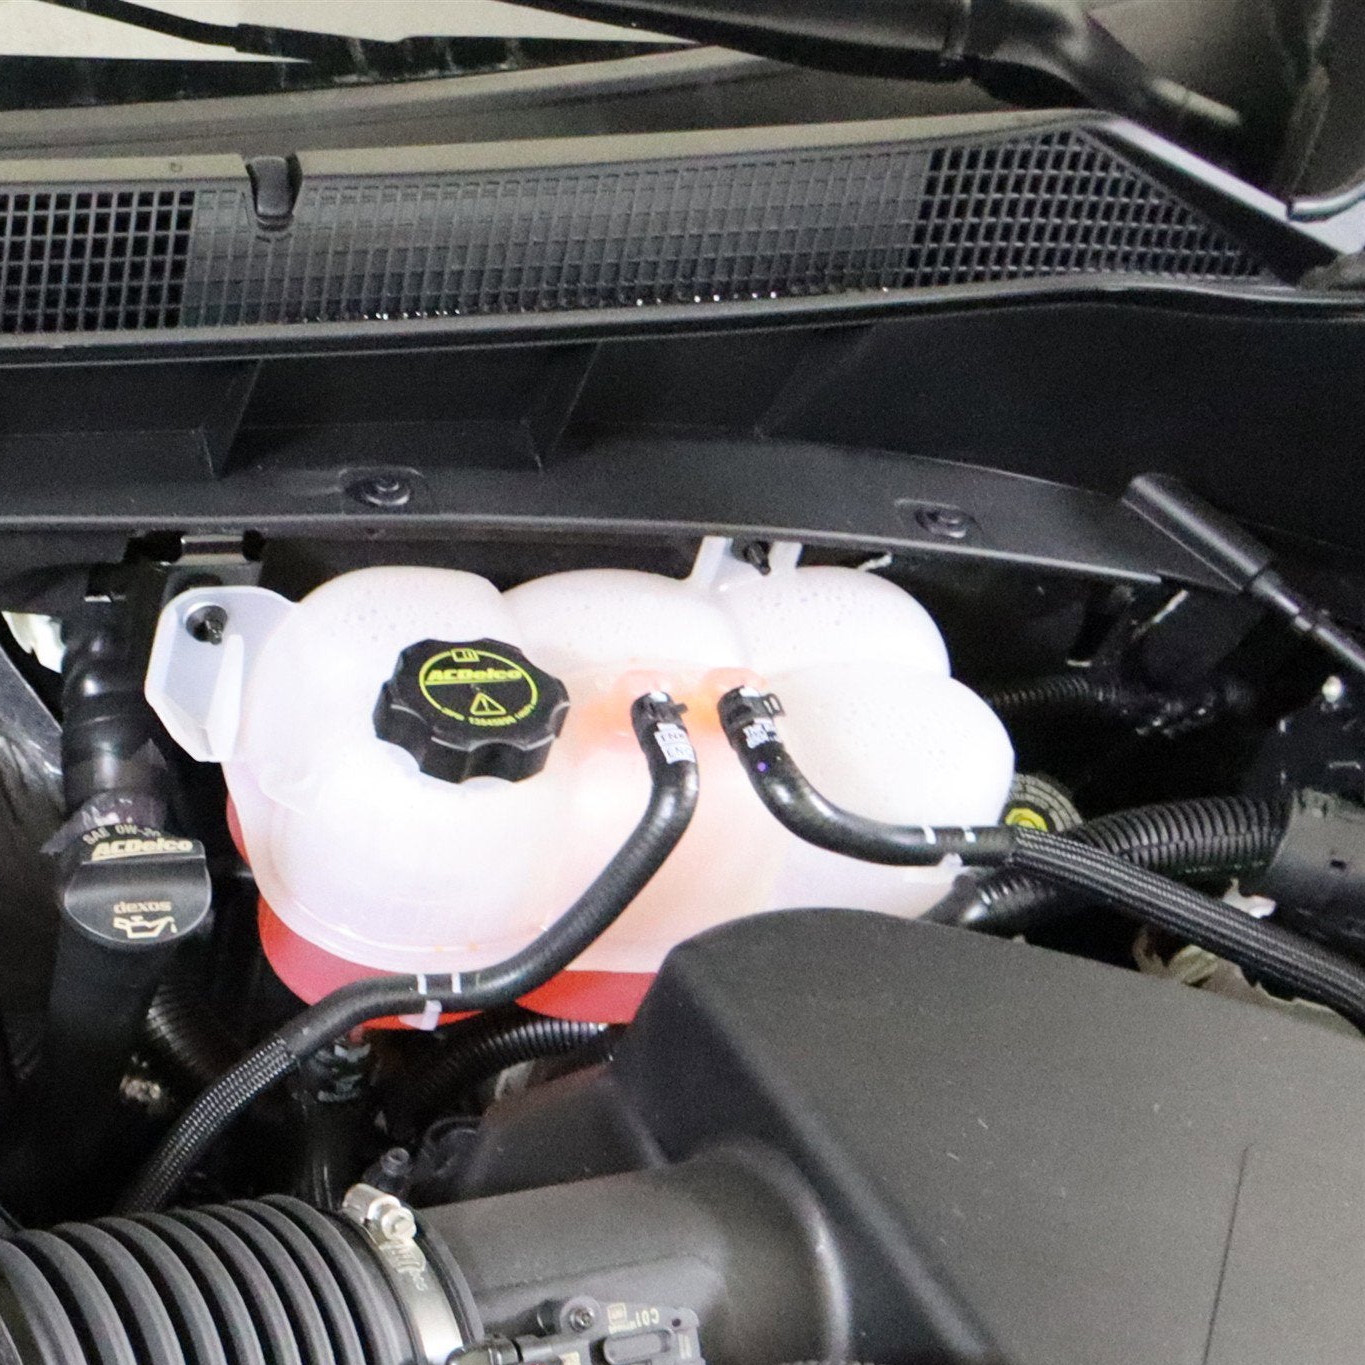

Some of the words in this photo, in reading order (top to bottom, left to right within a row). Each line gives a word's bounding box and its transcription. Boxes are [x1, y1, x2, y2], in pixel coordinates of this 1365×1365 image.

[426, 667, 525, 685] ACDelco
[82, 826, 111, 845] SAE
[92, 837, 194, 859] ACDelco
[112, 901, 172, 914] dexos
